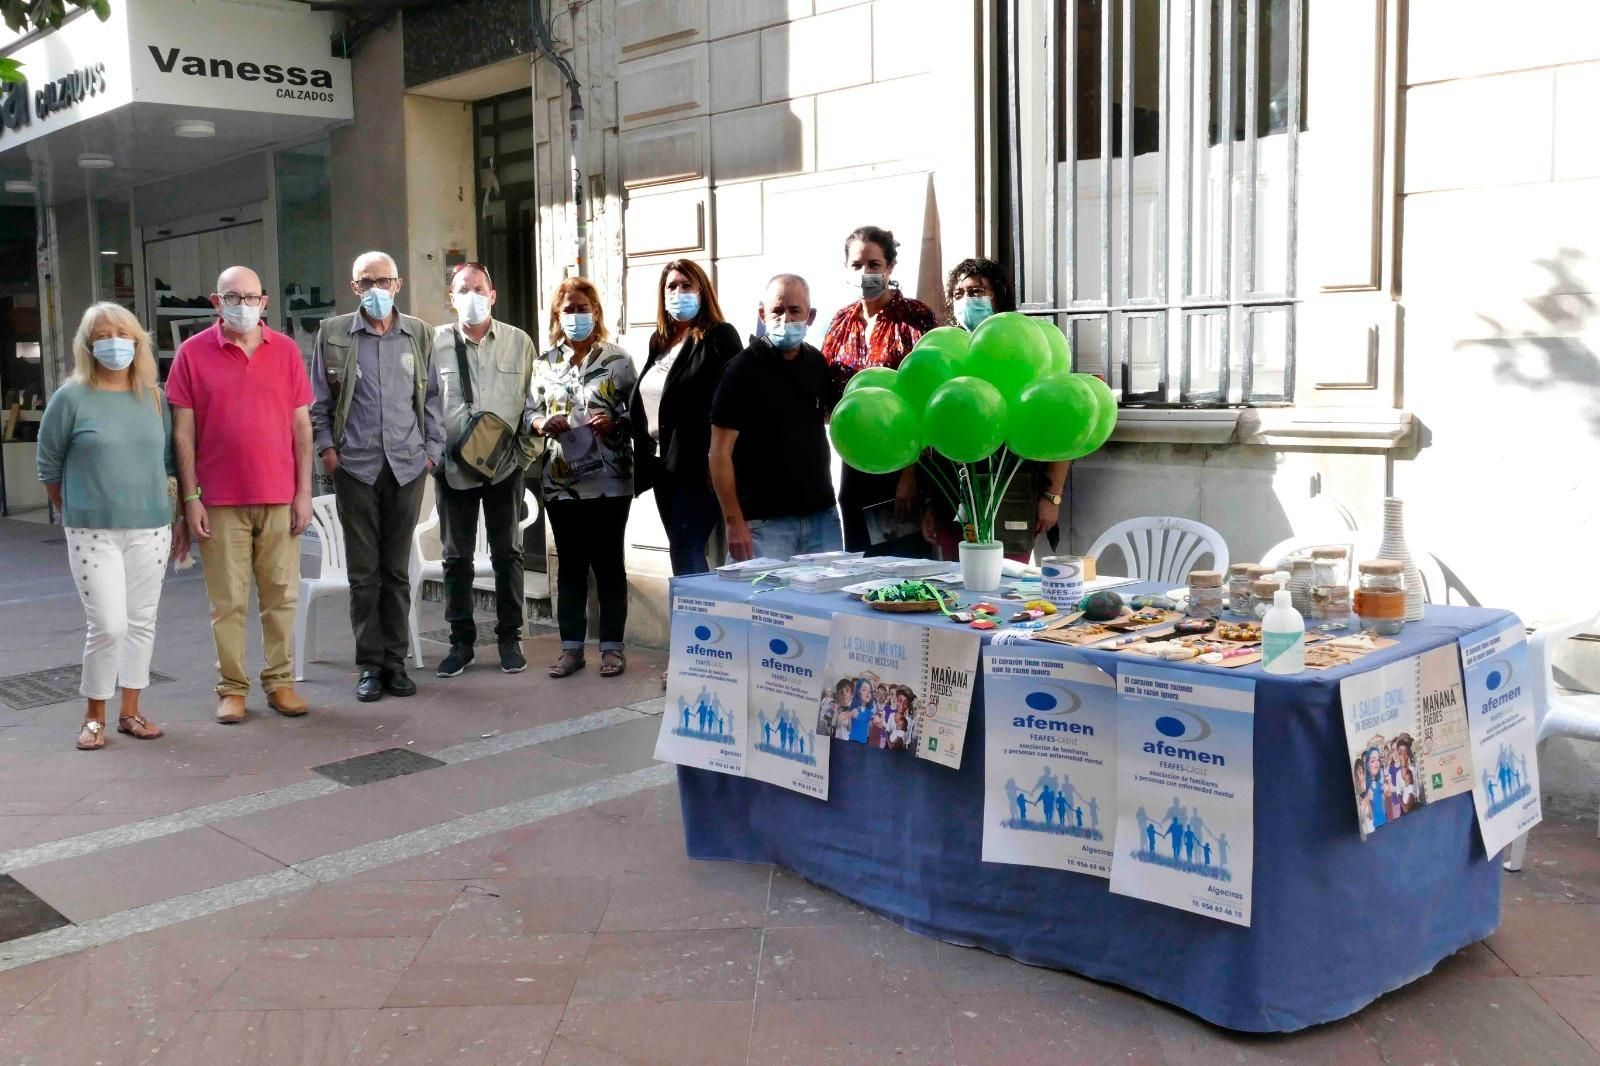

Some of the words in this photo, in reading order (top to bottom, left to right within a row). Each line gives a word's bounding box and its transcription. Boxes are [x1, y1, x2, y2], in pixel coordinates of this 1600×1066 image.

[148, 45, 333, 88] Vanessa
[35, 61, 106, 121] CALZADOS
[276, 88, 334, 103] CALZADOS
[686, 644, 732, 660] afemen
[762, 658, 813, 678] afemen
[932, 666, 968, 689] MAÑANA
[930, 682, 953, 697] PUEDES
[930, 694, 939, 706] SER
[1422, 688, 1456, 714] MAÑANA
[1481, 686, 1520, 715] afemen
[1012, 714, 1094, 736] afemen
[1423, 710, 1443, 726] PUEDES
[1424, 727, 1434, 737] SER
[1143, 740, 1225, 766] afemen
[1207, 884, 1243, 900] Algeciras
[1201, 902, 1213, 911] 956
[1224, 908, 1233, 916] 46
[1234, 910, 1243, 919] 10
